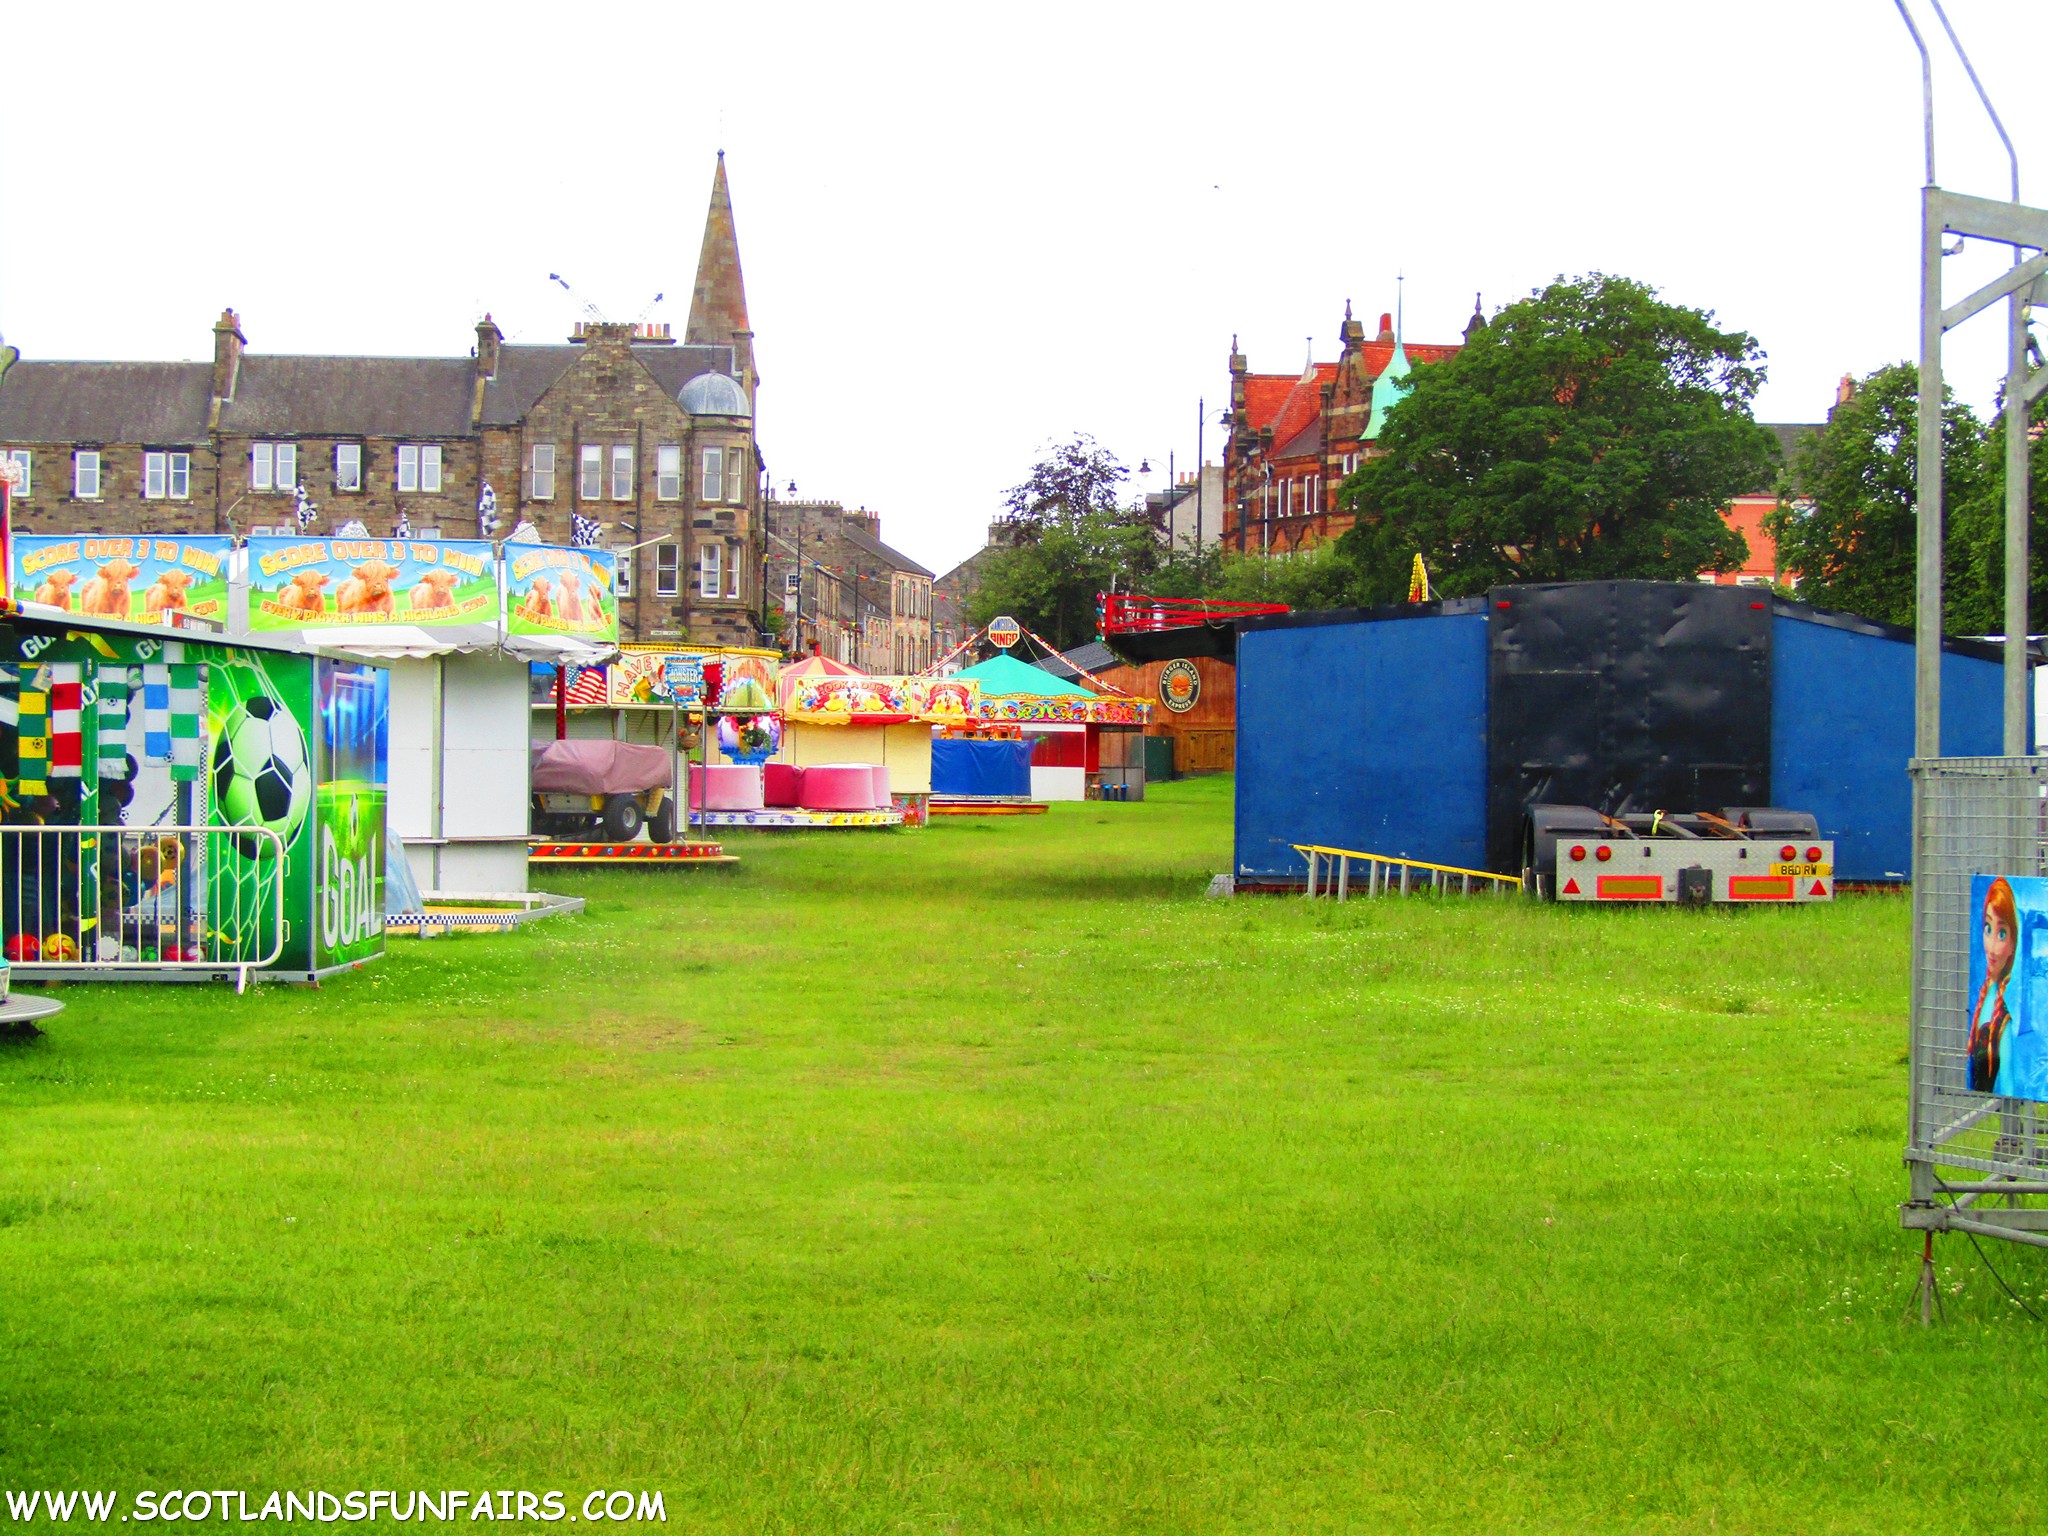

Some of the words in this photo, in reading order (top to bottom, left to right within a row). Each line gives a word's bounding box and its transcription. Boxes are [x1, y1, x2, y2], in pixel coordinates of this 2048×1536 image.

[22, 541, 81, 575] SCORE
[85, 538, 133, 559] OVER
[136, 539, 150, 558] 3
[156, 541, 178, 562] TO
[182, 546, 220, 576] WIN
[259, 543, 327, 576] SCORE
[331, 541, 387, 560] OVER
[391, 542, 404, 559] 3
[410, 544, 437, 563] TO
[443, 547, 484, 577] WIN
[260, 599, 303, 621] EVERY
[303, 609, 350, 623] PLAYER
[353, 610, 388, 623] WINS
[389, 610, 399, 623] A
[402, 605, 460, 623] HIGHLAND
[460, 594, 488, 613] COW
[990, 633, 1018, 646] BINGO
[616, 656, 653, 697] HAVE
[1162, 662, 1180, 684] BURGER
[1181, 662, 1198, 685] ISLAND
[1168, 699, 1191, 709] EXPRESS
[323, 822, 382, 948] GOAL
